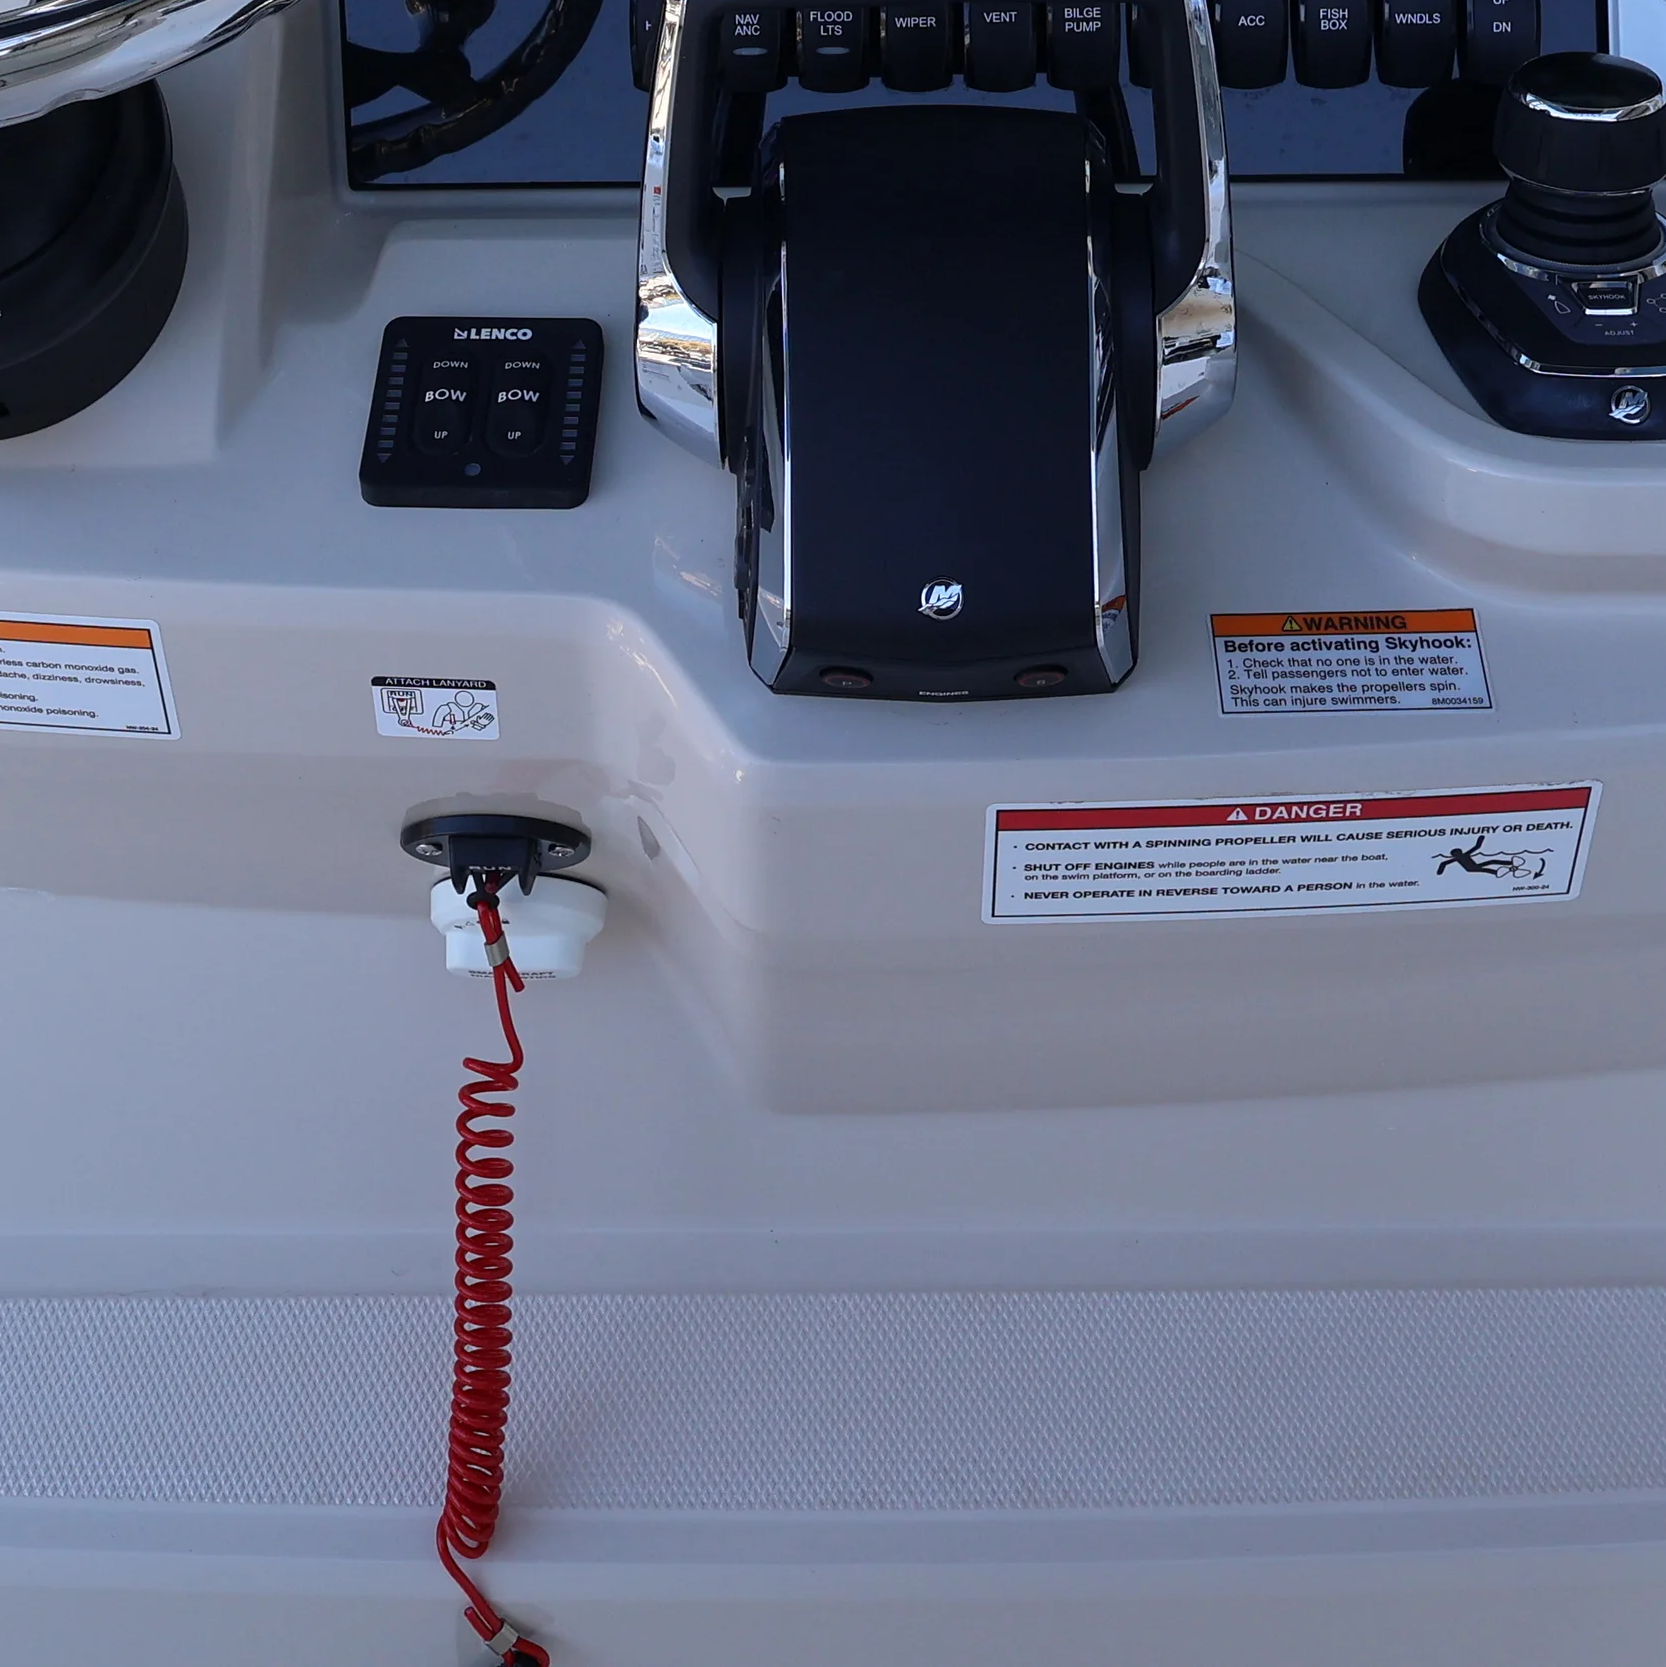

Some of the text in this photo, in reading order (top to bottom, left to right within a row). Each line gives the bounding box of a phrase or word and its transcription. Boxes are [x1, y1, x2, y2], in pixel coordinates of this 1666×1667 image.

[809, 11, 853, 22] FLOOD
[983, 11, 1018, 23] VENT
[1064, 7, 1101, 19] BILGE
[1319, 8, 1349, 19] FISH
[1394, 13, 1441, 24] WNDLS
[735, 14, 760, 25] NAV
[894, 16, 937, 28] WIPER
[1238, 15, 1265, 26] ACC
[1320, 19, 1348, 30] BOX
[734, 25, 761, 36] ANC
[820, 25, 843, 36] LTS
[1064, 21, 1101, 32] PUMP
[1493, 21, 1511, 32] DN
[469, 328, 533, 340] LENCO
[433, 360, 469, 369] DOWN
[504, 361, 540, 370] DOWN
[424, 388, 467, 402] BOW
[497, 389, 540, 403] BOW
[434, 430, 449, 439] UP
[507, 431, 522, 440] UP
[1302, 615, 1406, 630] WARNING
[1223, 635, 1471, 653] Before activating Skyhook:
[25, 661, 61, 669] carbon
[63, 663, 114, 672] monoxide
[1226, 654, 1457, 668] 1. Check that no one is in the water.
[1227, 665, 1468, 680] 2. Tell passengers not to enter water.
[385, 677, 487, 688] ATTACH LANYARD
[1229, 680, 1460, 696] Skyhook makes the propellers spin.
[1230, 694, 1400, 707] This can injure swimmers.
[1431, 696, 1483, 705] 8M0034159
[1254, 802, 1362, 820] DANGER
[1024, 821, 1572, 850] CONTACT WITH A SPINNING PROPELLER WILL CAUSE SERIOUS INJURY OR DEATH.
[1023, 863, 1061, 871] SHUT
[1064, 862, 1091, 871] OFF
[1094, 861, 1154, 870] ENGINES
[1188, 860, 1226, 869] people
[1024, 891, 1068, 899] NEVER
[1072, 889, 1135, 898] OPERATE
[1155, 887, 1218, 896] REVERSE
[1221, 885, 1281, 894] TOWARD
[1283, 884, 1293, 892] A
[1297, 881, 1352, 891] PERSON
